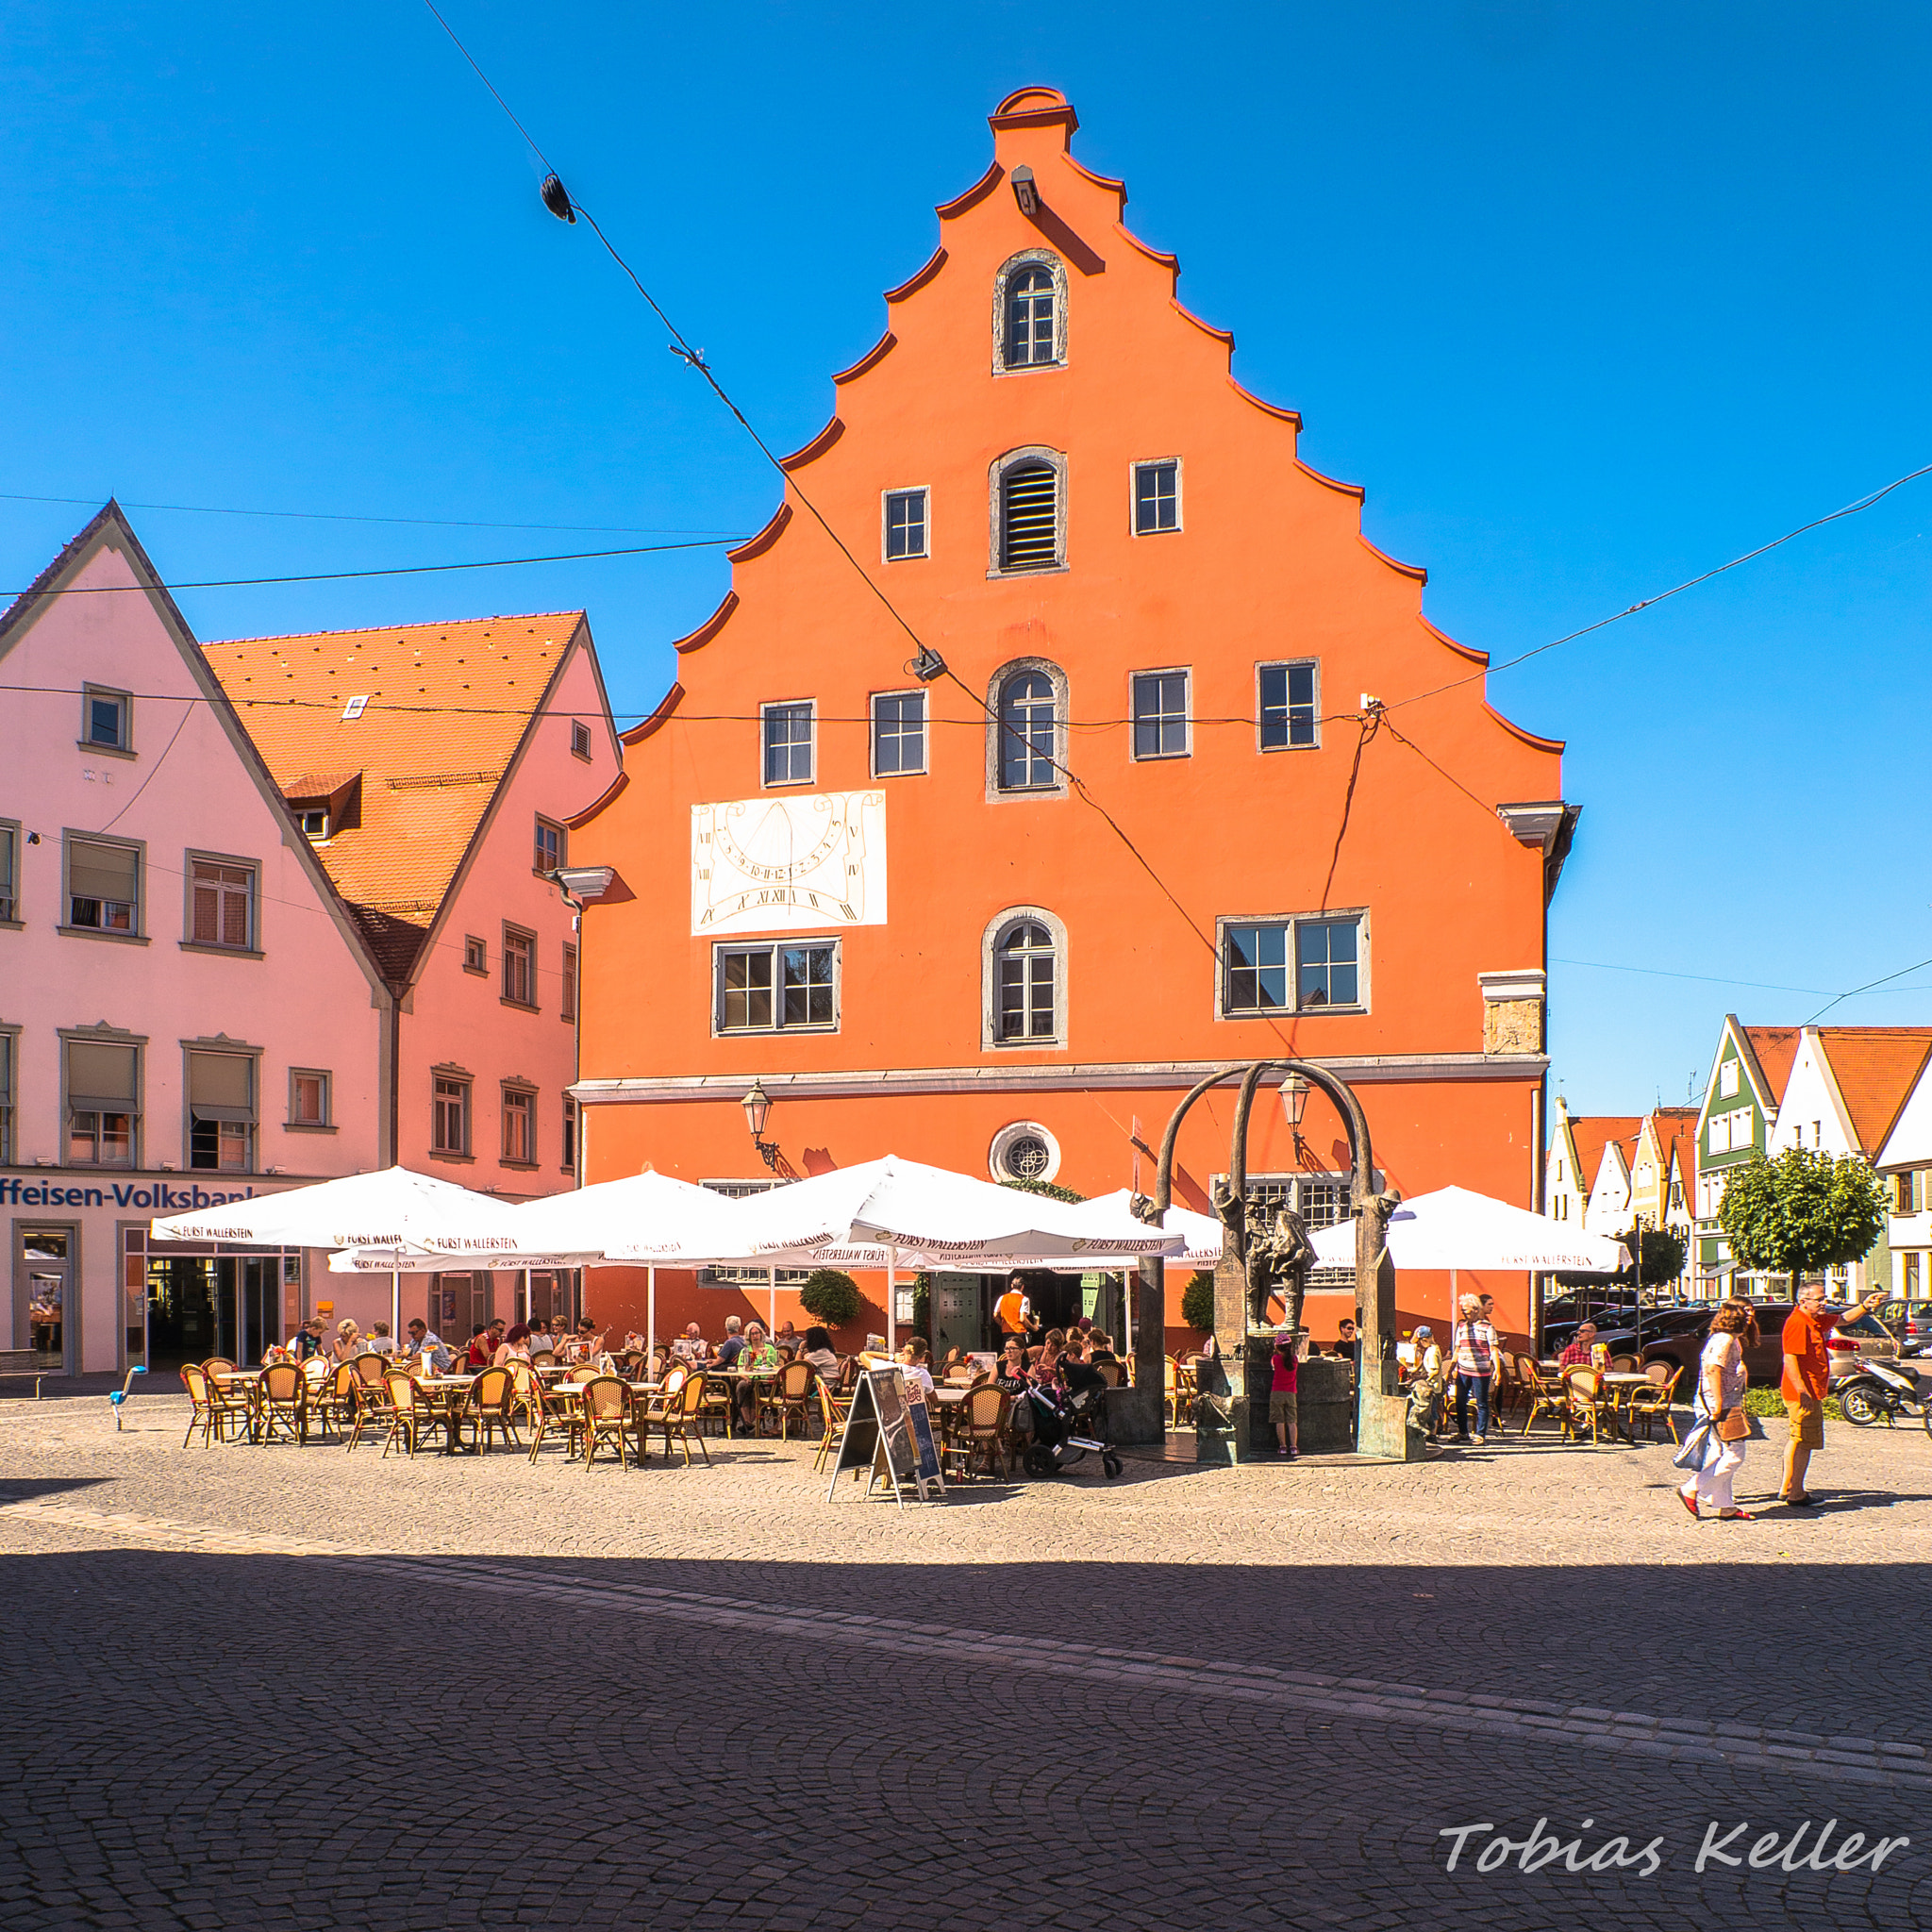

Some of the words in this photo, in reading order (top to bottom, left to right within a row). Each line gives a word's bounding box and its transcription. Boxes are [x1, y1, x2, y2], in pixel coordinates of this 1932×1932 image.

[750, 865, 760, 876] 10
[772, 889, 786, 903] XII
[206, 1226, 254, 1239] WALLERSTEIN
[464, 1237, 518, 1249] WALLERSTEIN
[1113, 1239, 1166, 1252] WALLERSTEIN
[374, 1260, 416, 1269] WALLESTEIN
